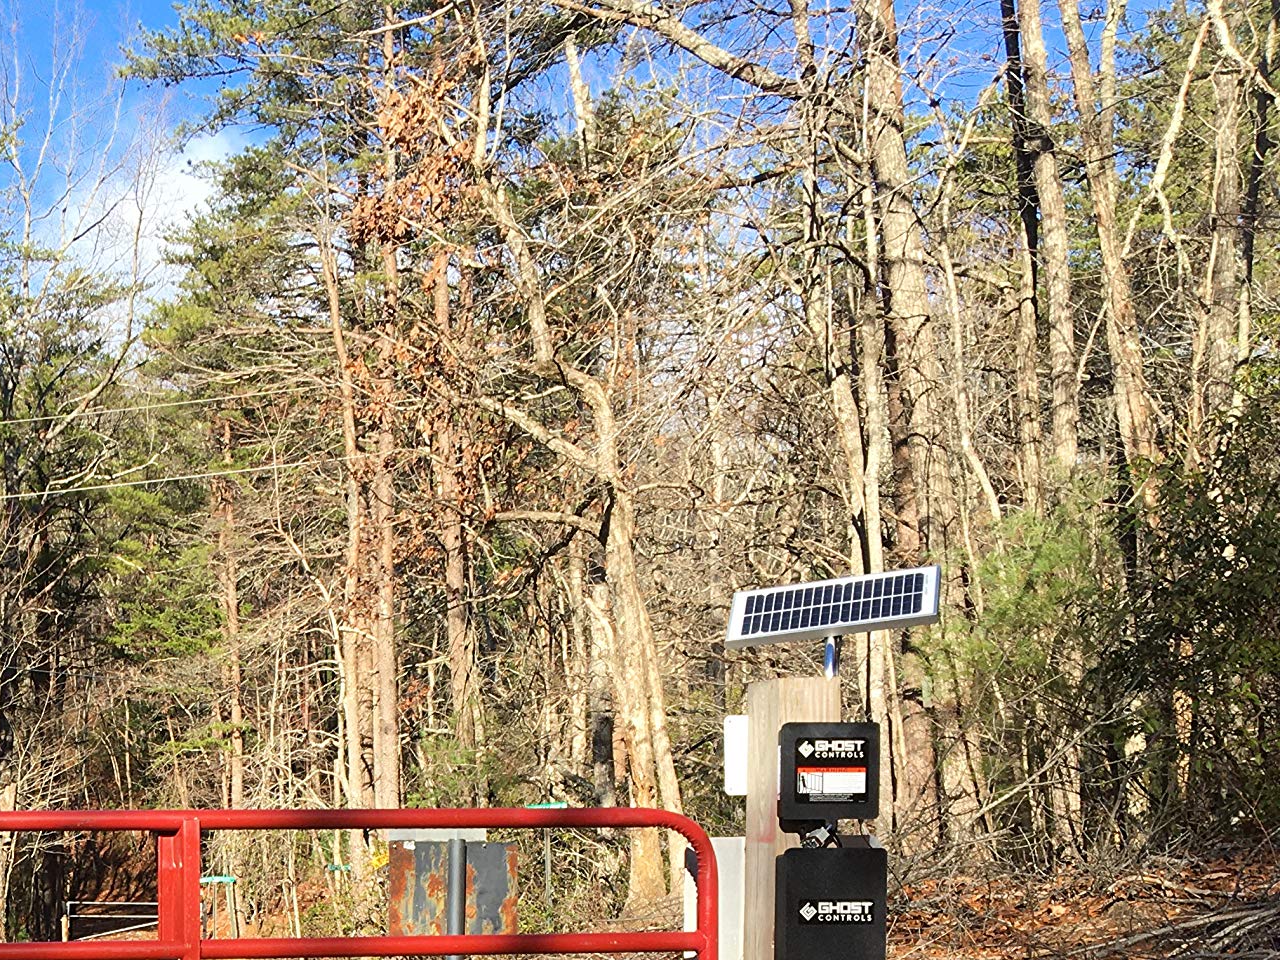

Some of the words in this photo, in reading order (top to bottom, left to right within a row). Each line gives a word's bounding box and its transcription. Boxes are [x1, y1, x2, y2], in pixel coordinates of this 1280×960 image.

[814, 740, 866, 751] GHOST
[814, 751, 865, 759] CONTROLS
[818, 901, 874, 914] GHOST
[818, 914, 873, 922] CONTROLS
